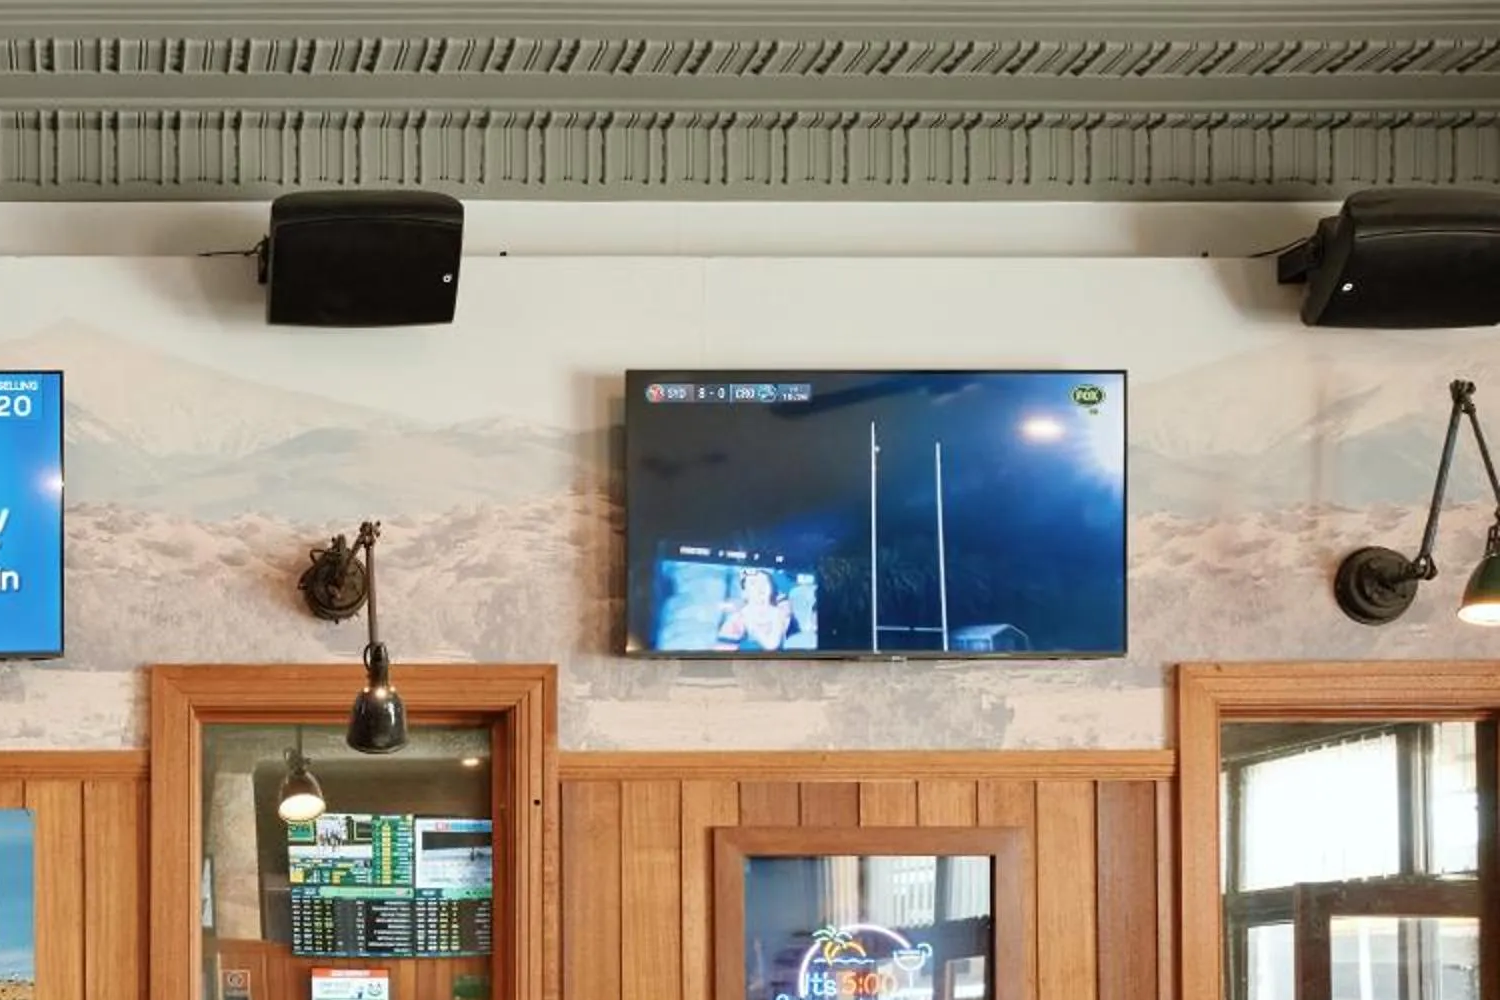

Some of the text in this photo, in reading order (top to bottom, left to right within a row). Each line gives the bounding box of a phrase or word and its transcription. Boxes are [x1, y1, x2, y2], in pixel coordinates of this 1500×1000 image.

[1075, 390, 1097, 401] FOX
[803, 971, 899, 996] It's 5:00
